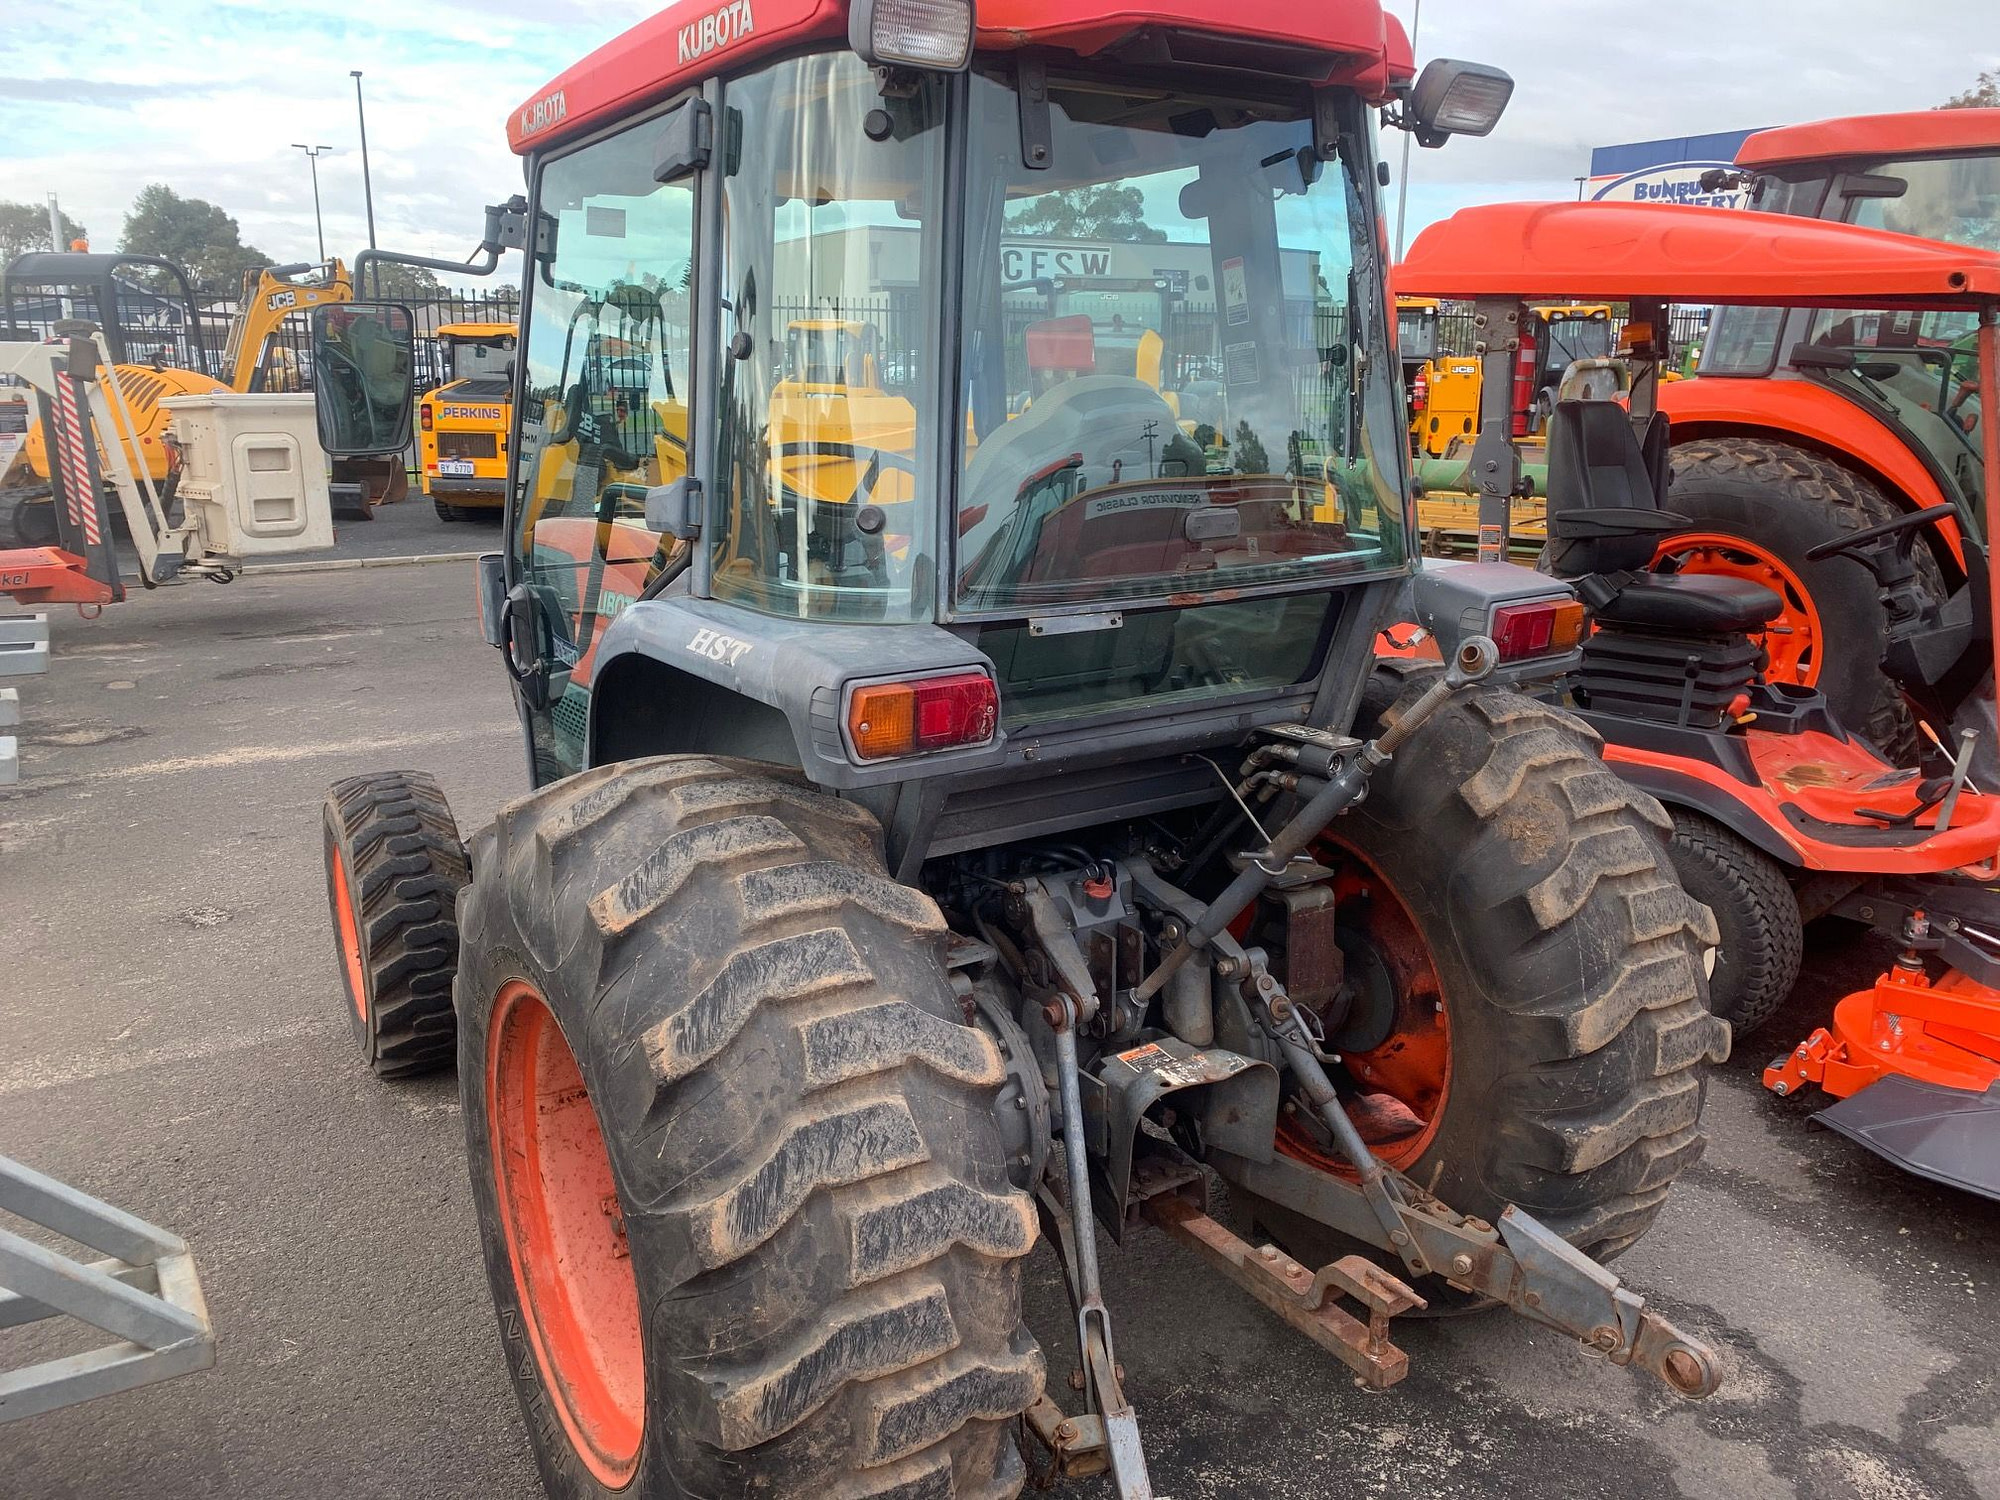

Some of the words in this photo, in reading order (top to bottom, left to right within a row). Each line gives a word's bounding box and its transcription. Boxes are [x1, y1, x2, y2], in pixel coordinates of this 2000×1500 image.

[677, 0, 754, 64] KUBOTA
[1634, 178, 1716, 200] BUNBU
[267, 291, 297, 311] JCB
[443, 407, 501, 419] PERKINS
[441, 464, 450, 472] BY
[2, 571, 29, 586] kel
[597, 590, 636, 615] UBOT
[685, 628, 754, 667] HST
